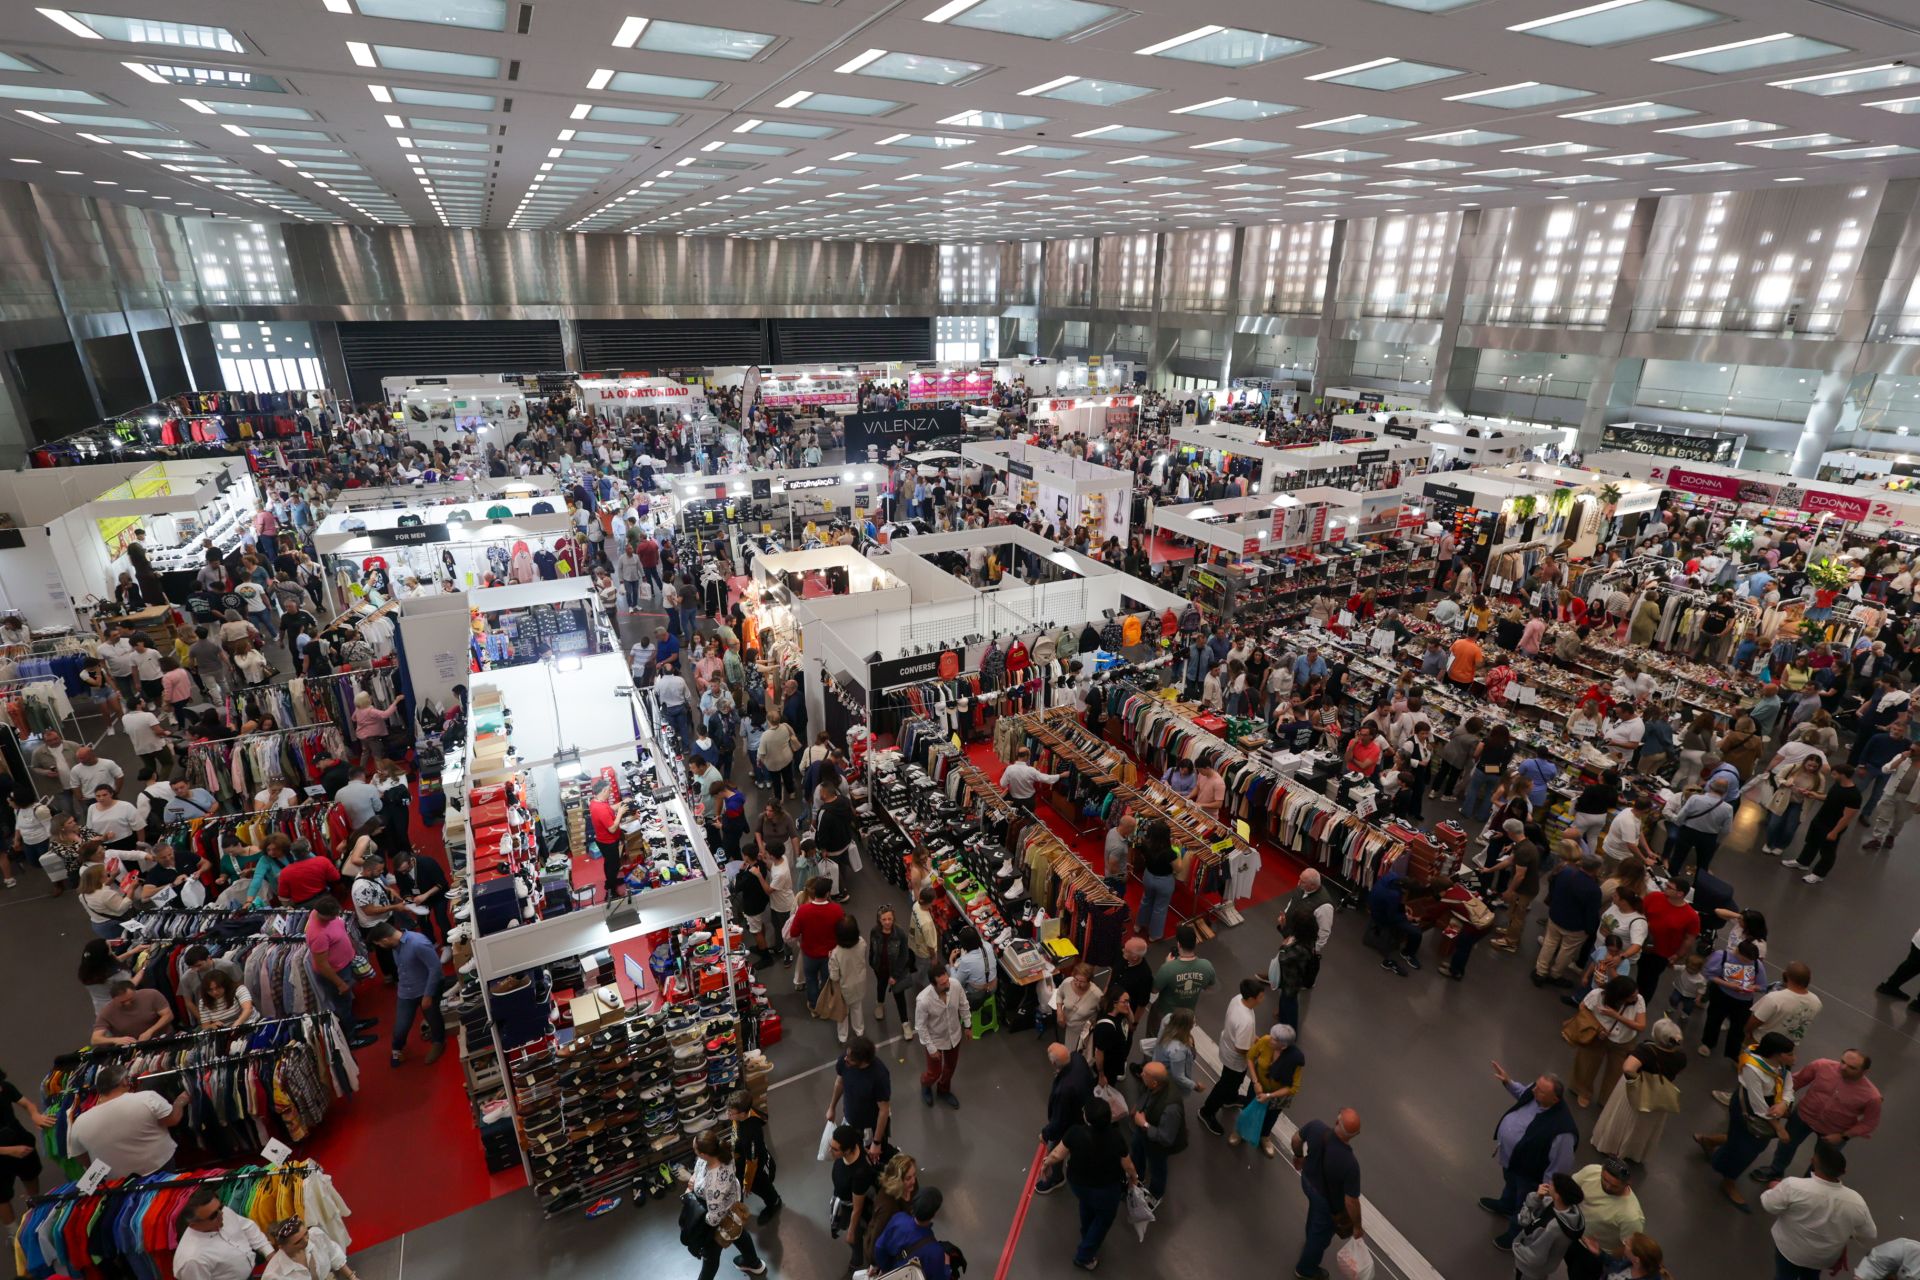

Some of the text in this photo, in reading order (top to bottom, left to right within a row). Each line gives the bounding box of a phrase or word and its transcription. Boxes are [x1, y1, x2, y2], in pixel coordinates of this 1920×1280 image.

[601, 387, 689, 399] LA OPORTUNIDAD
[863, 417, 940, 434] VALENZA
[1635, 443, 1657, 454] 70%
[1677, 449, 1702, 460] 80%
[855, 497, 869, 505] EA7
[395, 531, 426, 541] FOR MEN
[899, 661, 936, 675] CONVERSE
[1176, 972, 1203, 982] DICKIES
